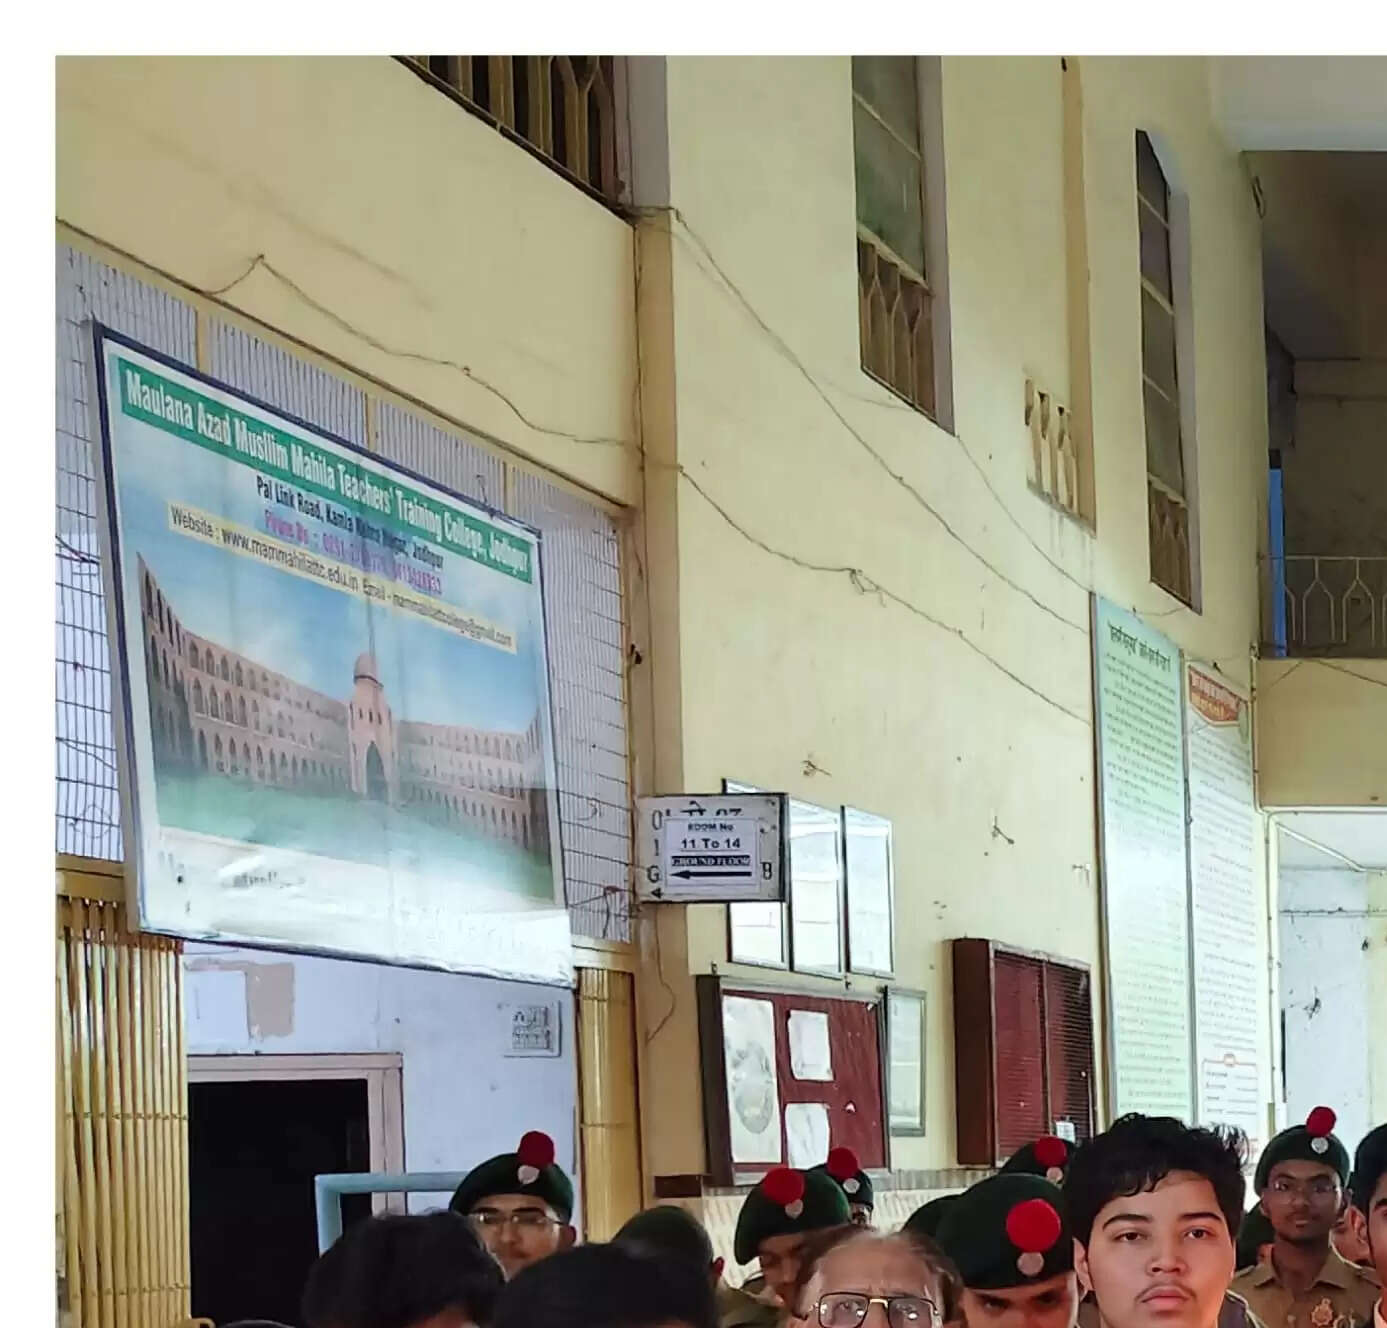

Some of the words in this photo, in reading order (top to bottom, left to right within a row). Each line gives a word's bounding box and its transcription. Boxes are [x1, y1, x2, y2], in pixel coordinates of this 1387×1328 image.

[125, 370, 194, 430] Maulana
[197, 401, 232, 447] Azad
[681, 837, 697, 849] 11
[701, 837, 720, 849] To
[725, 837, 742, 849] 14
